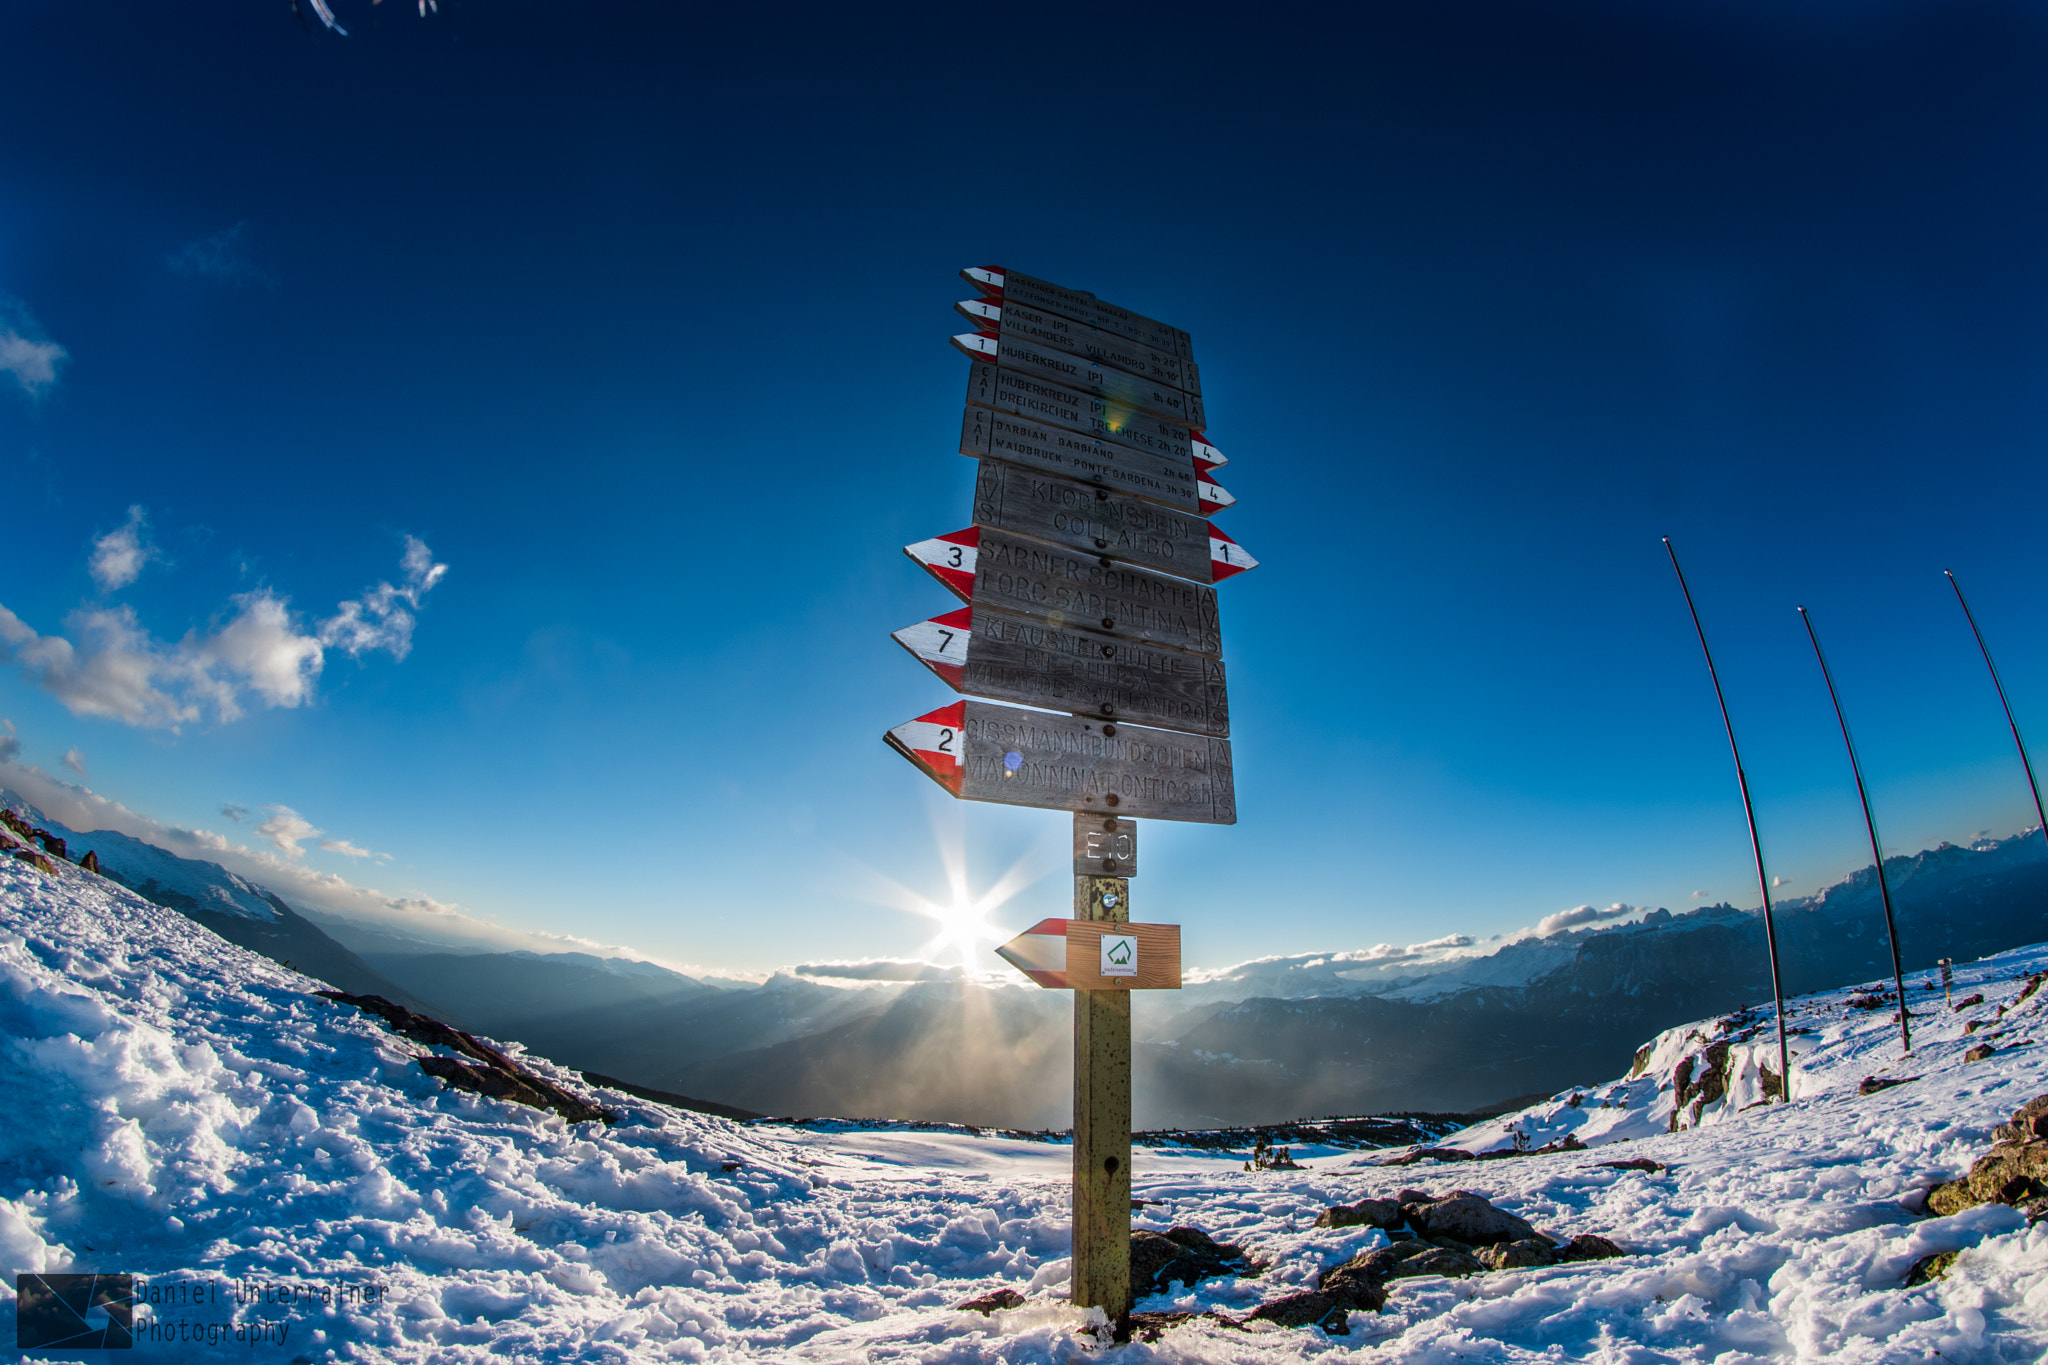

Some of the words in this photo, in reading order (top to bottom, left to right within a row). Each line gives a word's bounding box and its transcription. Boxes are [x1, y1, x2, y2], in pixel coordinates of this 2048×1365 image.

[986, 272, 992, 282] 1
[982, 305, 988, 316] 1
[1007, 286, 1061, 307] LATZFONSER
[1063, 304, 1089, 317] KREUZ
[978, 338, 984, 350] 1
[1004, 319, 1074, 348] VILLANDERS
[1085, 343, 1146, 372] VILLANDRO
[1151, 366, 1164, 377] 3h
[1005, 306, 1043, 325] KASER
[1150, 352, 1161, 363] 1h
[979, 366, 990, 398] CAI
[1001, 346, 1078, 376] HUBERKREUZ
[1152, 391, 1164, 404] 1h
[1186, 363, 1195, 390] CAI
[999, 390, 1078, 423] DREIKIRCHEN
[1090, 416, 1111, 433] TRE
[1157, 439, 1170, 452] 2h
[1000, 375, 1080, 408] HUBERKREUZ
[1158, 423, 1169, 436] 1h
[1190, 395, 1200, 425] CAI
[973, 411, 984, 446] CAI
[996, 420, 1048, 442] BARBIAN
[1058, 437, 1114, 460] BARBIANO
[1162, 467, 1175, 478] 2h
[996, 438, 1062, 463] WAIDBRUCK
[1074, 458, 1110, 476] PONTE
[1112, 468, 1161, 490] GARDENA
[1166, 484, 1178, 495] 3h
[1202, 446, 1212, 458] 4
[978, 463, 1000, 523] AVS
[1032, 478, 1188, 540] KLOBENSTEIN
[1210, 487, 1218, 500] 4
[947, 546, 962, 568] 3
[1054, 512, 1175, 560] COLLALBO
[1219, 544, 1229, 562] 1
[978, 540, 1080, 582] SARNER
[1088, 566, 1194, 610] SCHARTE
[1056, 586, 1190, 638] SARENTINA
[1200, 588, 1220, 654] AVS
[937, 629, 954, 653] 7
[984, 618, 1104, 660] KLAUSNER
[1208, 663, 1226, 732] AVS
[938, 728, 952, 752] 2
[966, 718, 1084, 754] GISSMANN
[1092, 736, 1208, 772] BUNDSCHEN
[964, 754, 1098, 794] MADONNINA
[1211, 742, 1232, 818] AVS
